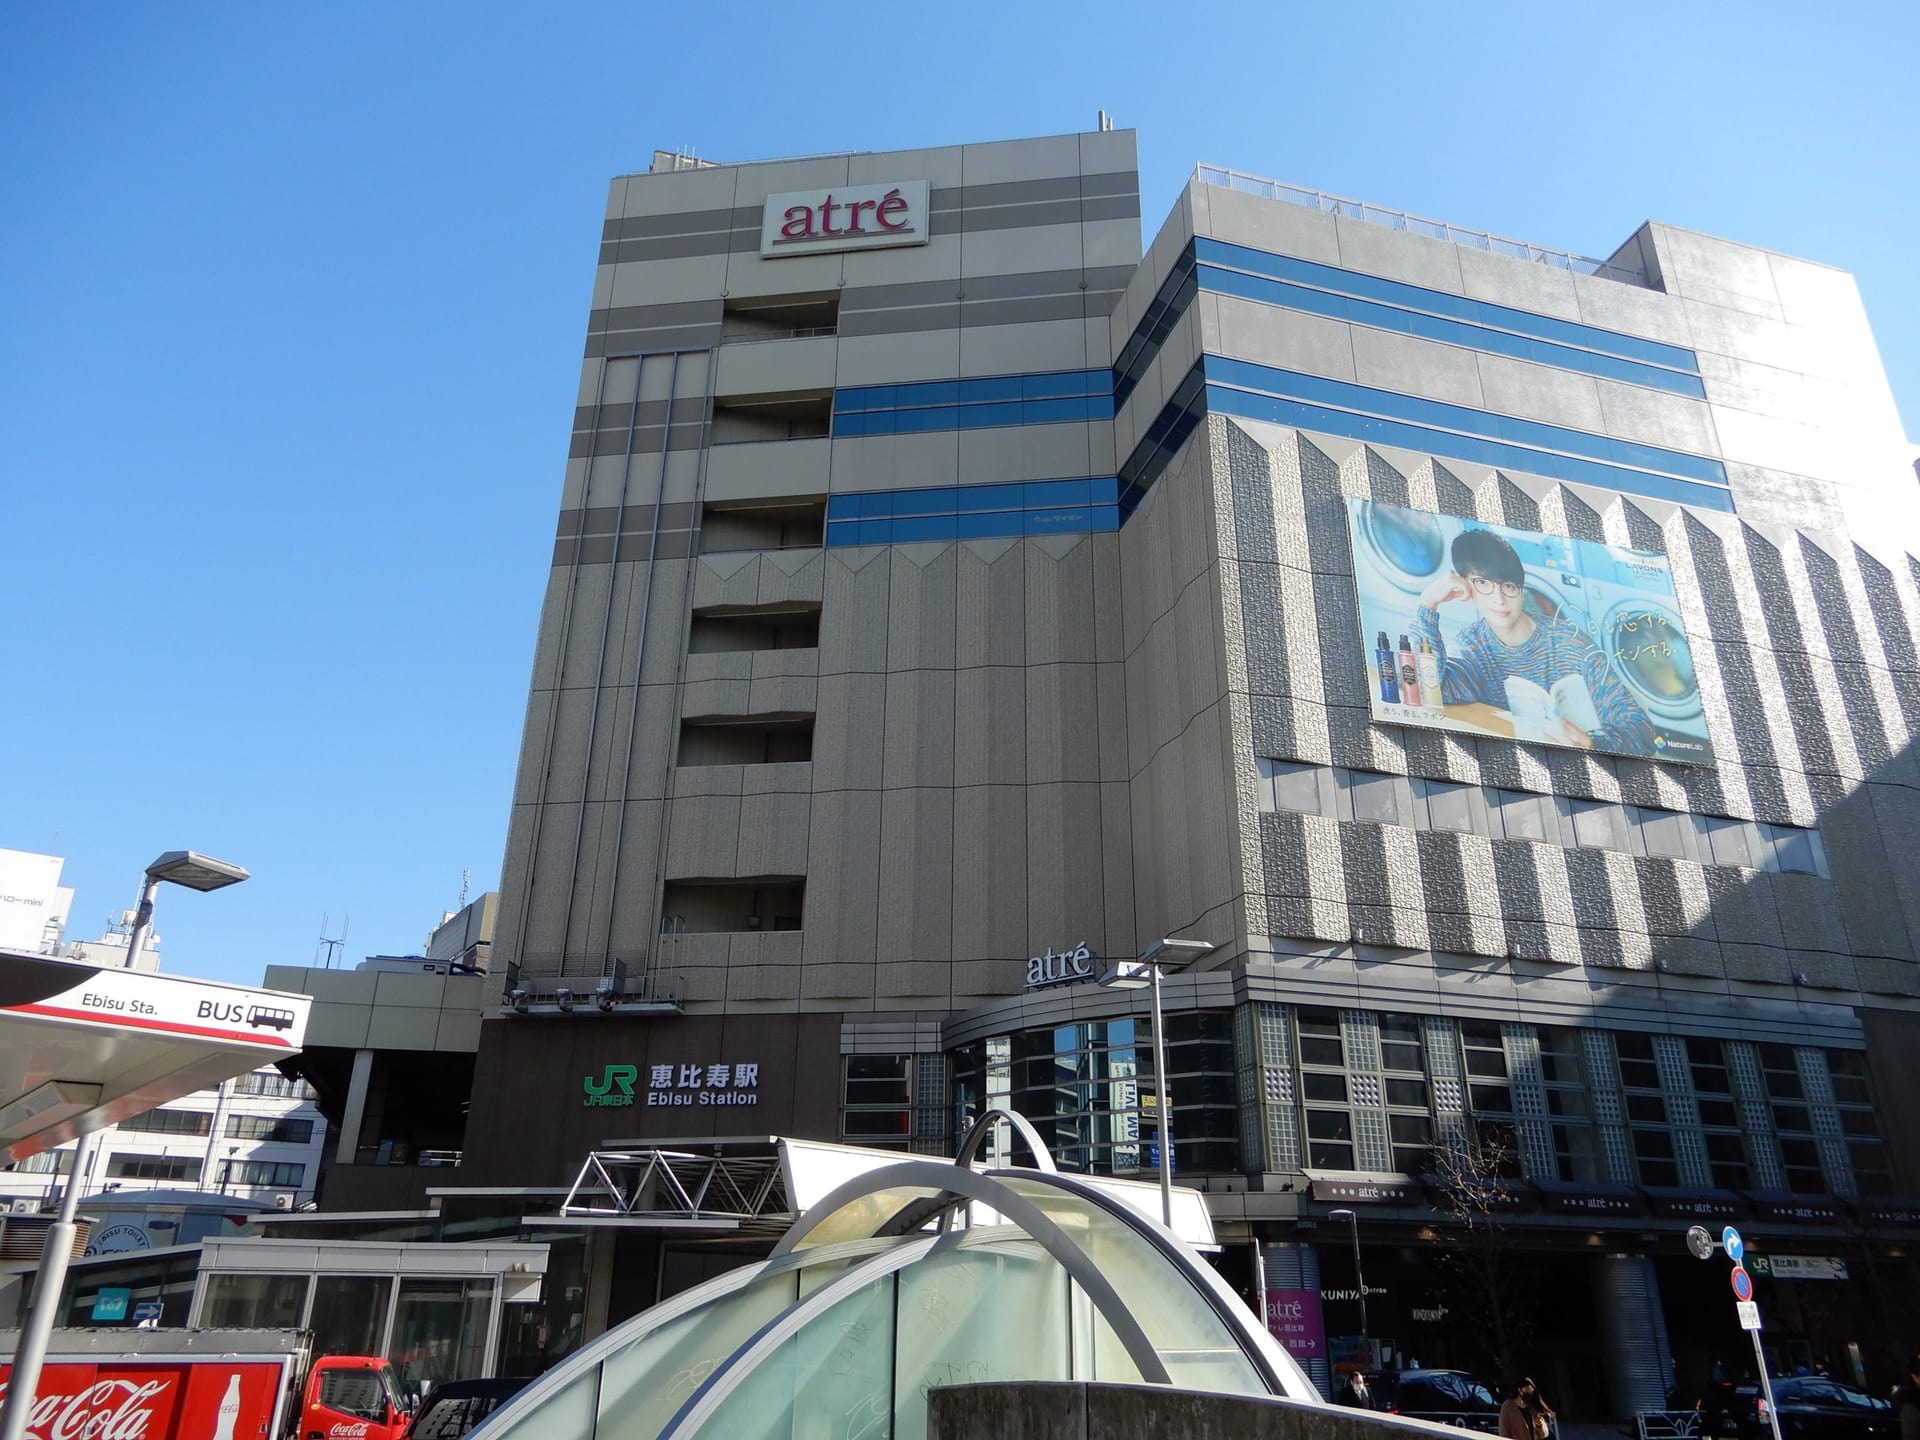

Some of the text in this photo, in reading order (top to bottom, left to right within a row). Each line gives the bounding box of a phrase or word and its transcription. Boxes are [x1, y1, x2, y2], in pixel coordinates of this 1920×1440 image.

[781, 188, 909, 238] atré
[1625, 561, 1664, 574] LAVONS
[1026, 940, 1092, 985] atré
[82, 992, 158, 1016] Ebisu Sta.
[197, 1000, 244, 1023] BUS
[584, 1064, 638, 1095] JR
[650, 1063, 759, 1089] 恵比寿駅
[647, 1091, 757, 1106] Ebisu Station
[1358, 1186, 1379, 1198] atré
[123, 1227, 146, 1248] TOILET
[1752, 1257, 1769, 1269] JR
[1268, 1300, 1302, 1317] atré
